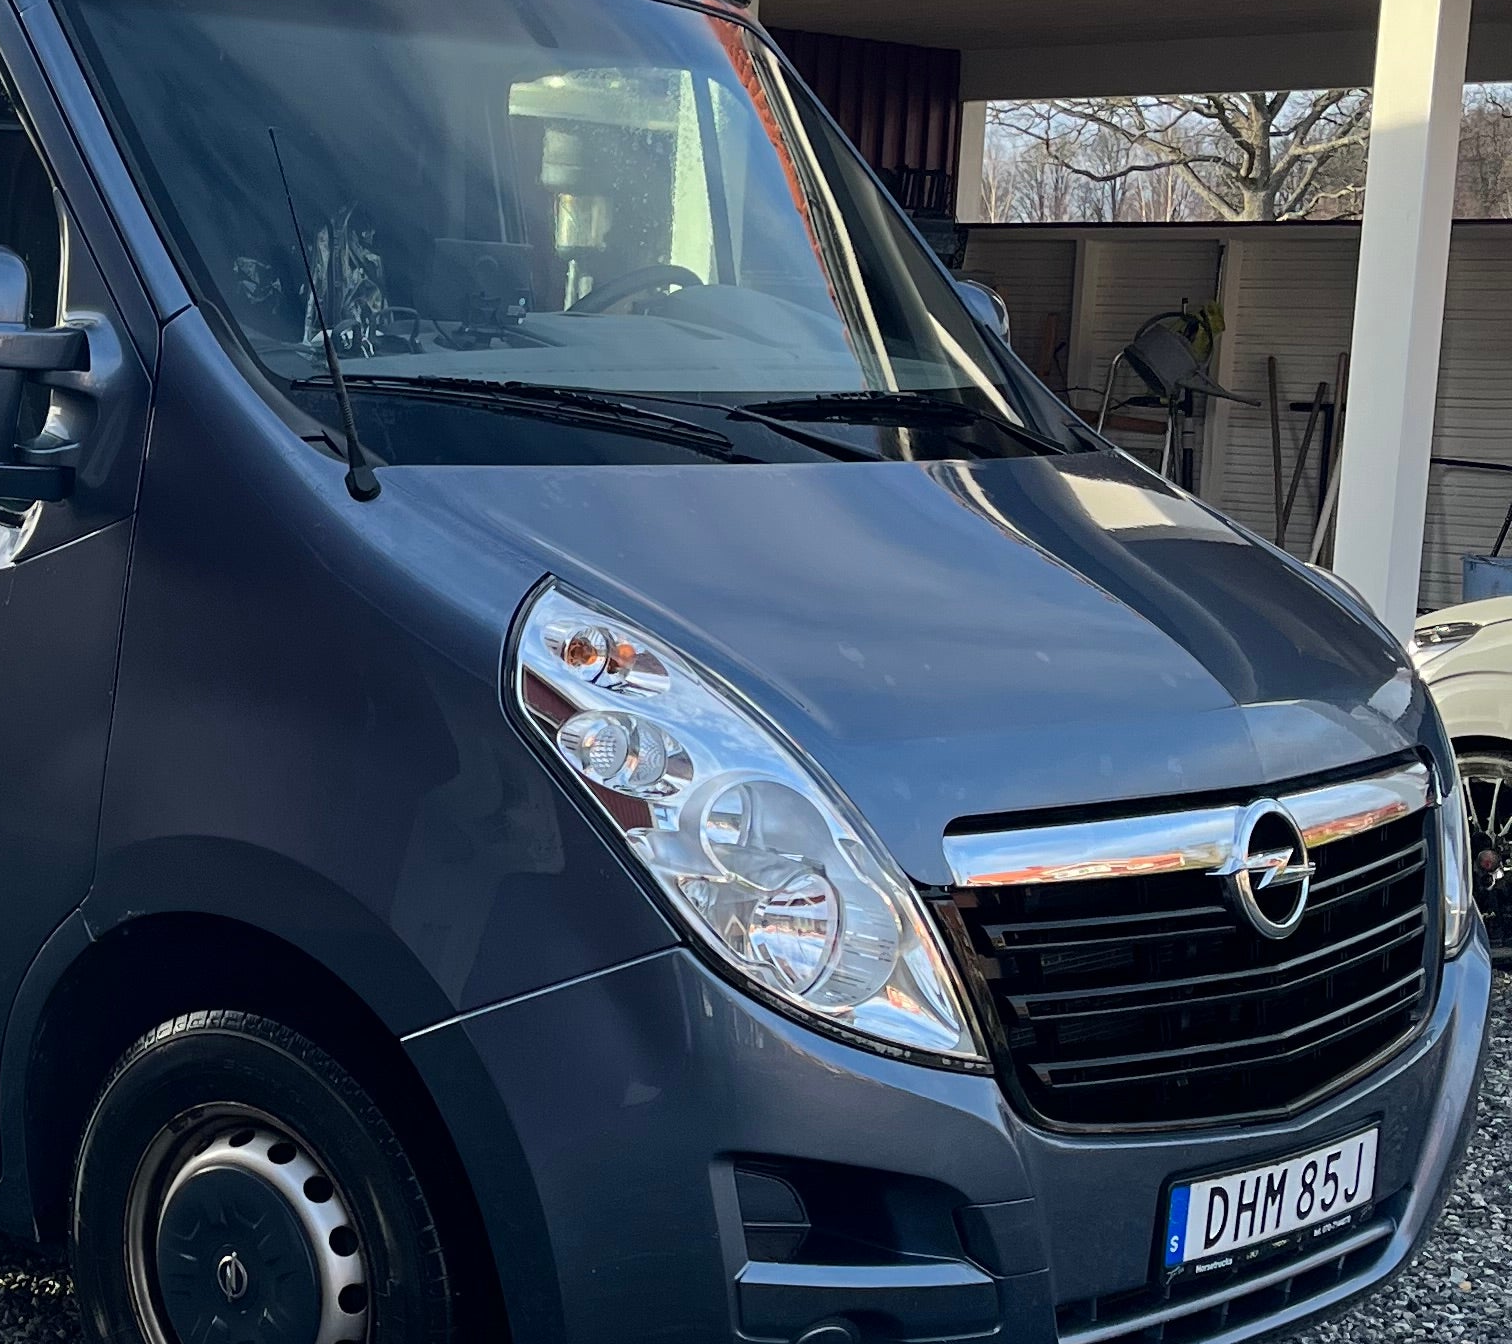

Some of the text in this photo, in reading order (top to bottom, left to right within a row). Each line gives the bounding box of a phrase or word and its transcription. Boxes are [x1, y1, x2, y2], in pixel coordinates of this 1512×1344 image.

[1203, 1142, 1363, 1249] DHM 85J
[1170, 1235, 1179, 1253] S
